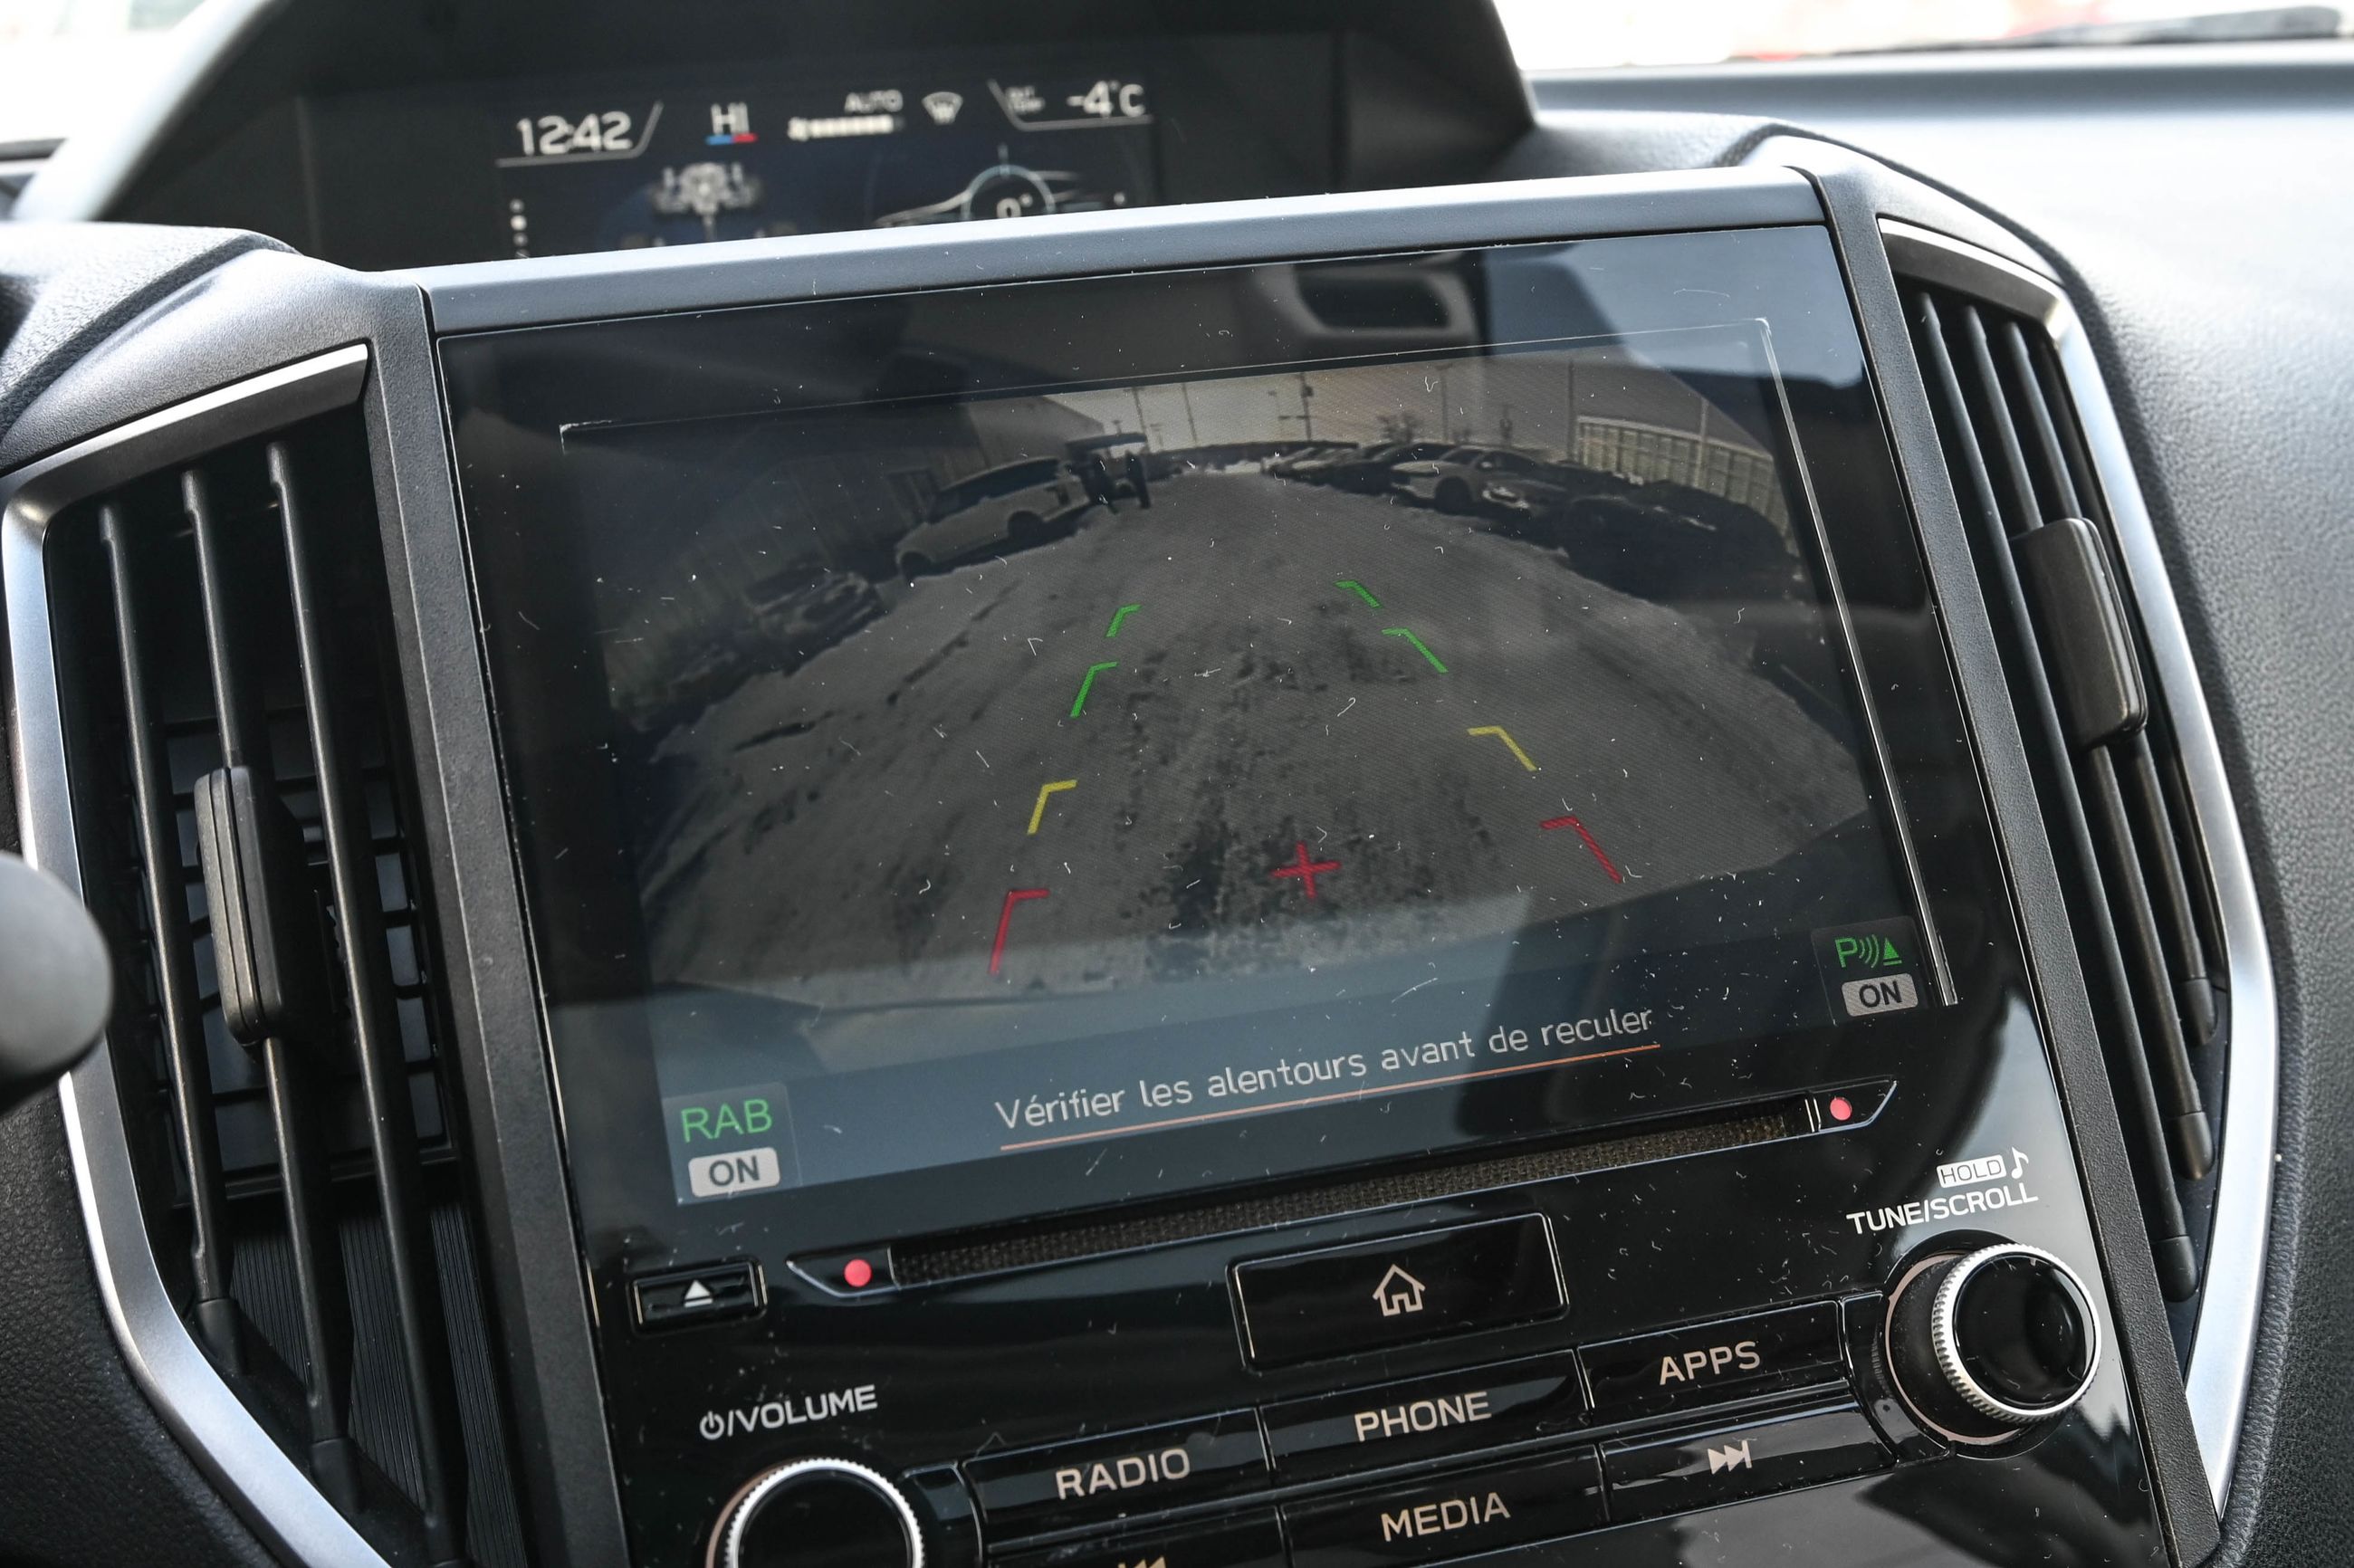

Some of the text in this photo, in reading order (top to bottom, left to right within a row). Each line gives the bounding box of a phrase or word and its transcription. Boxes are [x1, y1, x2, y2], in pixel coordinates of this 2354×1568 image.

[844, 90, 904, 114] AUTO
[1859, 980, 1902, 1008] ON
[995, 1006, 1654, 1131] Vérifier les alentours avant de reculer
[681, 1098, 772, 1143] RAB
[708, 1159, 760, 1188] ON
[1940, 1159, 2003, 1186] HOLD
[1846, 1182, 2039, 1235] TUNE/SCROLL
[1659, 1341, 1761, 1385] APPS
[1354, 1391, 1492, 1442] PHONE
[1055, 1448, 1191, 1500] RADIO
[1380, 1492, 1511, 1542] MEDIA
